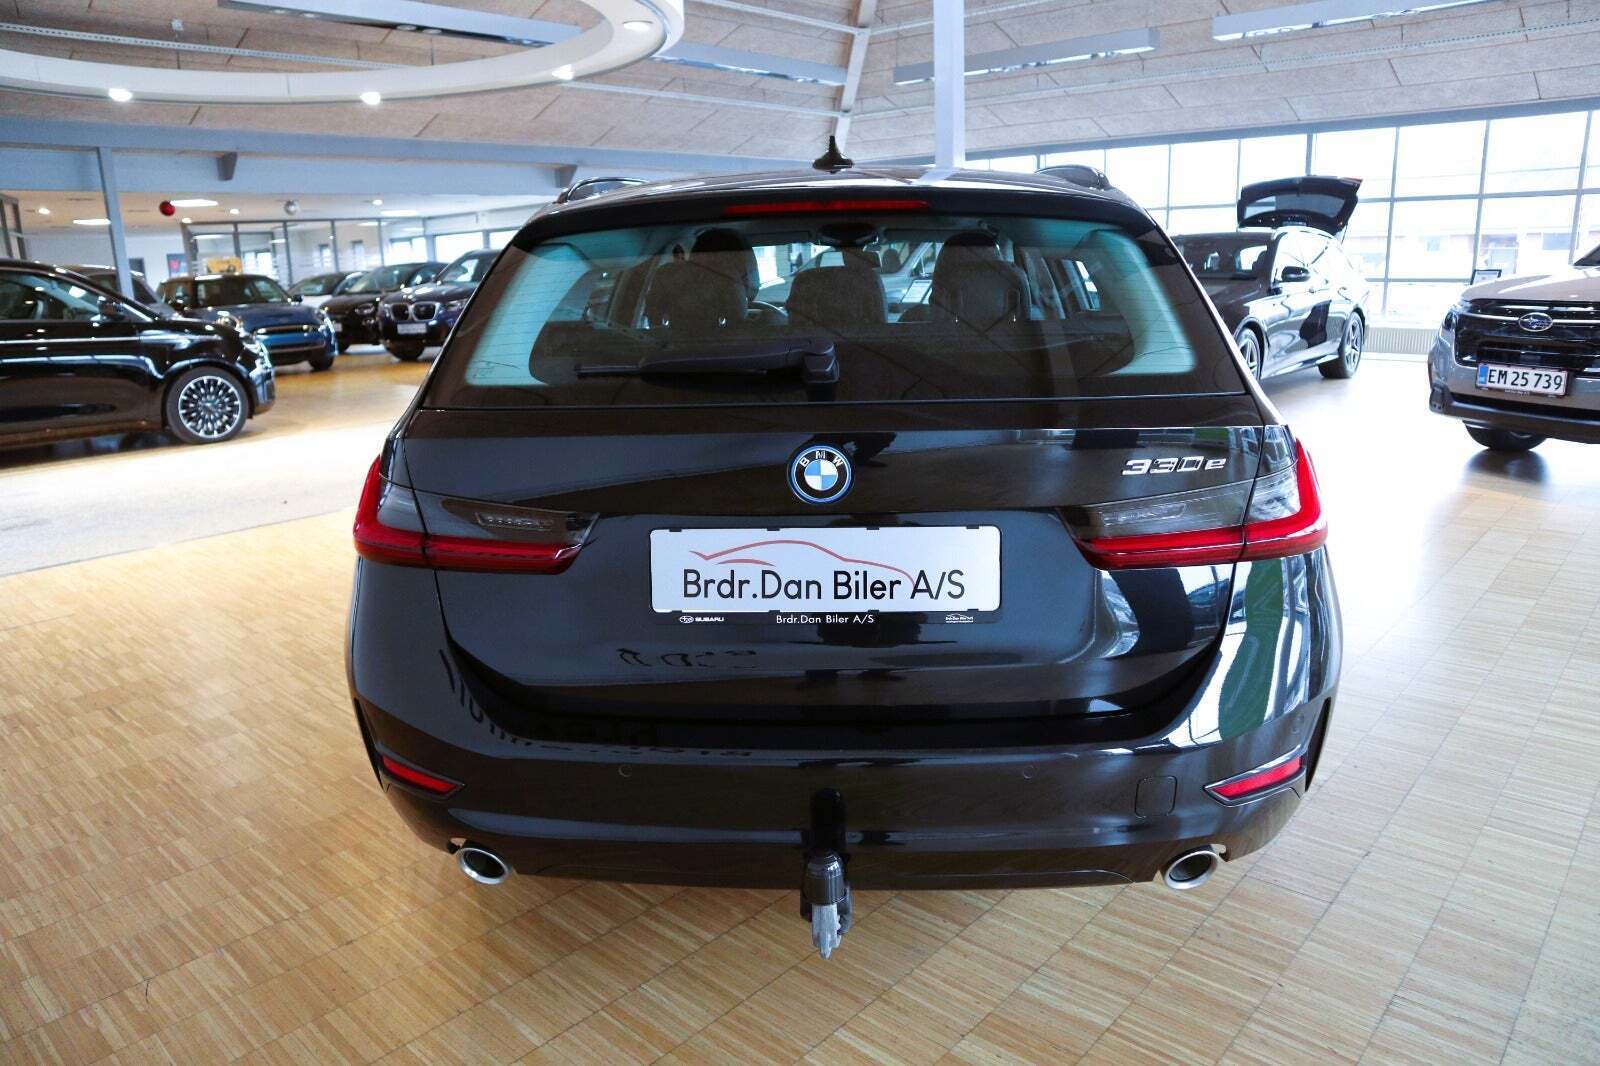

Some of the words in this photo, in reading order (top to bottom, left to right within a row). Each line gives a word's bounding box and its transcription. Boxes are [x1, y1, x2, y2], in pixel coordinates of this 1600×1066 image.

[1488, 369, 1508, 385] EM
[1510, 371, 1529, 387] 25
[1533, 373, 1563, 390] 739
[799, 450, 844, 468] BMW
[1122, 456, 1227, 475] 330e
[683, 568, 822, 600] Brdr.Dan
[833, 569, 902, 600] Biler
[910, 569, 966, 600] A/S
[825, 614, 849, 624] Biler
[852, 614, 875, 624] A/S
